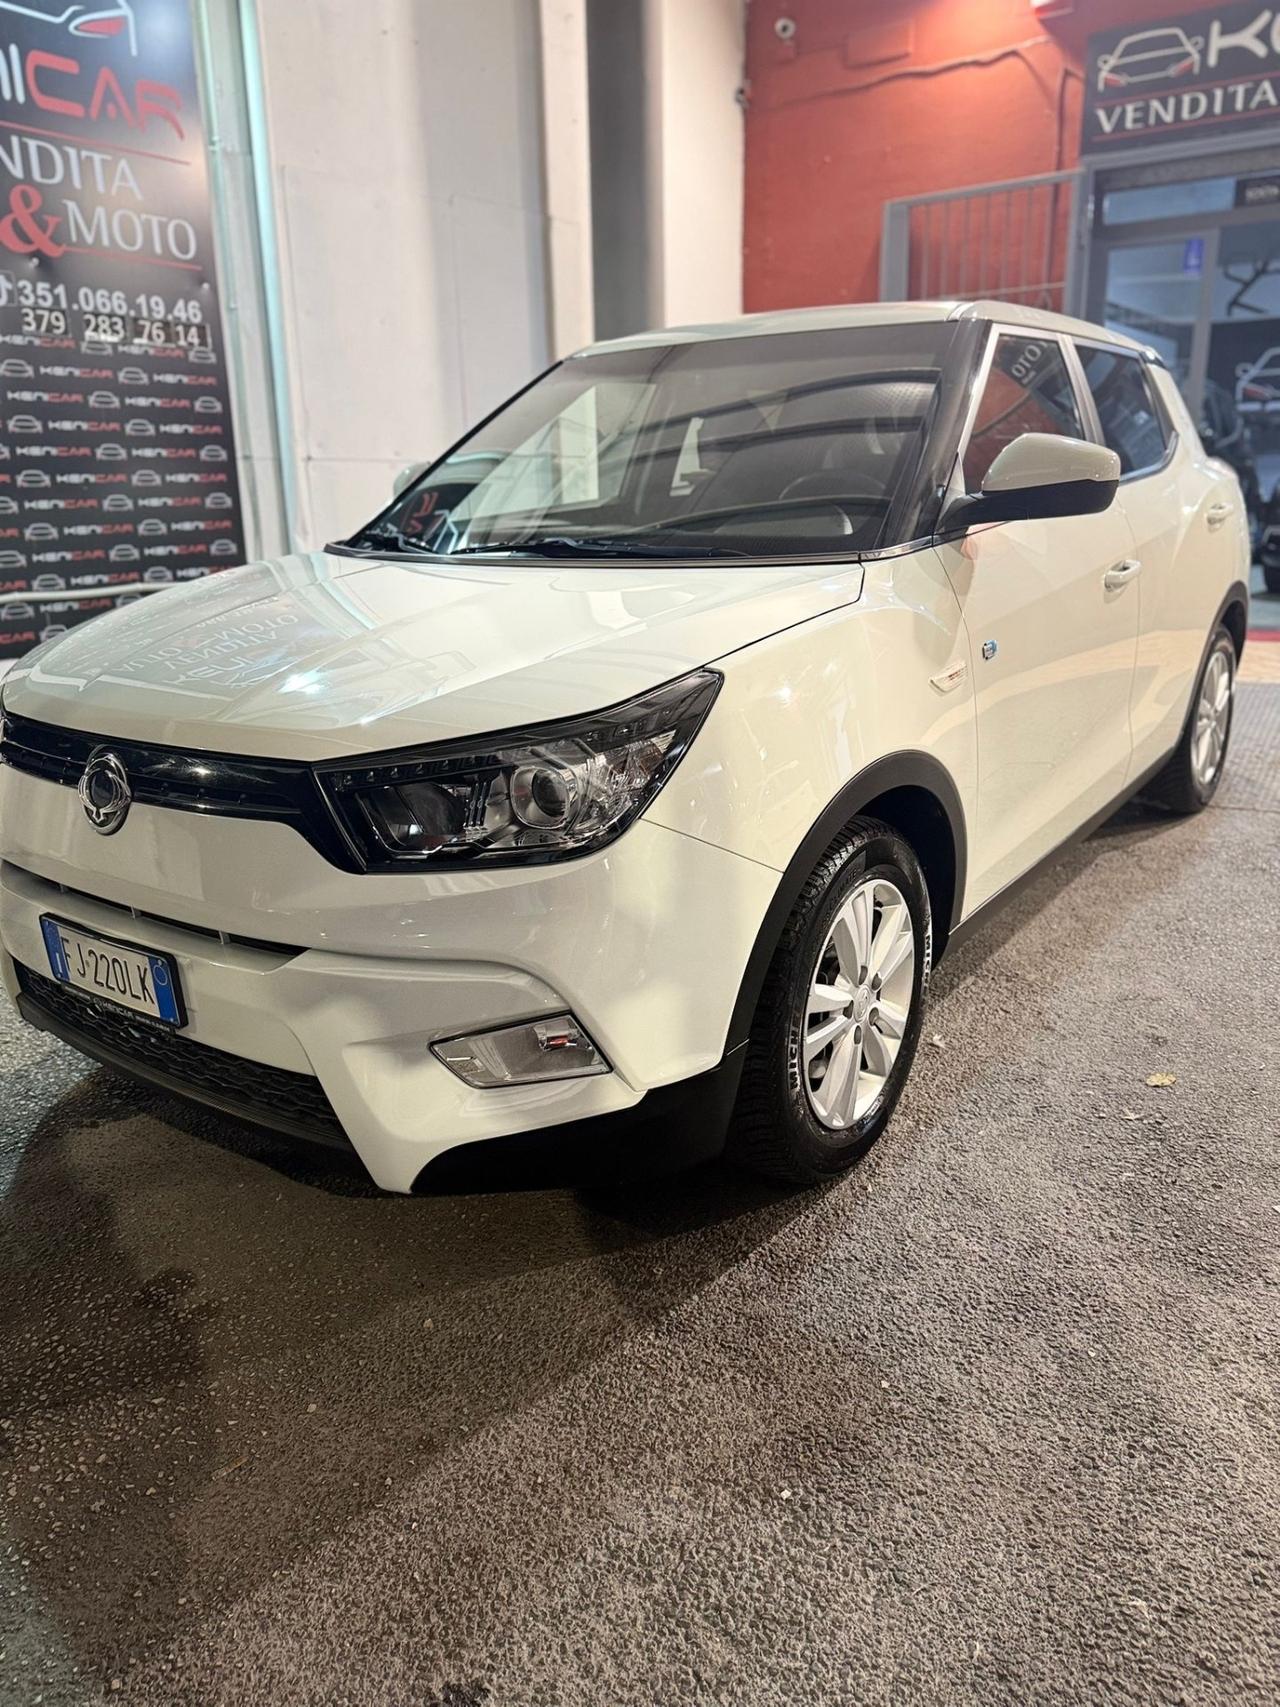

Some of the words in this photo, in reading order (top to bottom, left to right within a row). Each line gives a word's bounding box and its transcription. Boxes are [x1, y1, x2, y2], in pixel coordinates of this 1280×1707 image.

[1096, 79, 1278, 134] VENDITA
[62, 199, 197, 260] MOTO
[17, 279, 202, 324] 351.066.19.46
[21, 308, 66, 334] 379
[83, 313, 125, 341] 283
[137, 320, 166, 344] 76
[175, 324, 200, 347] 14
